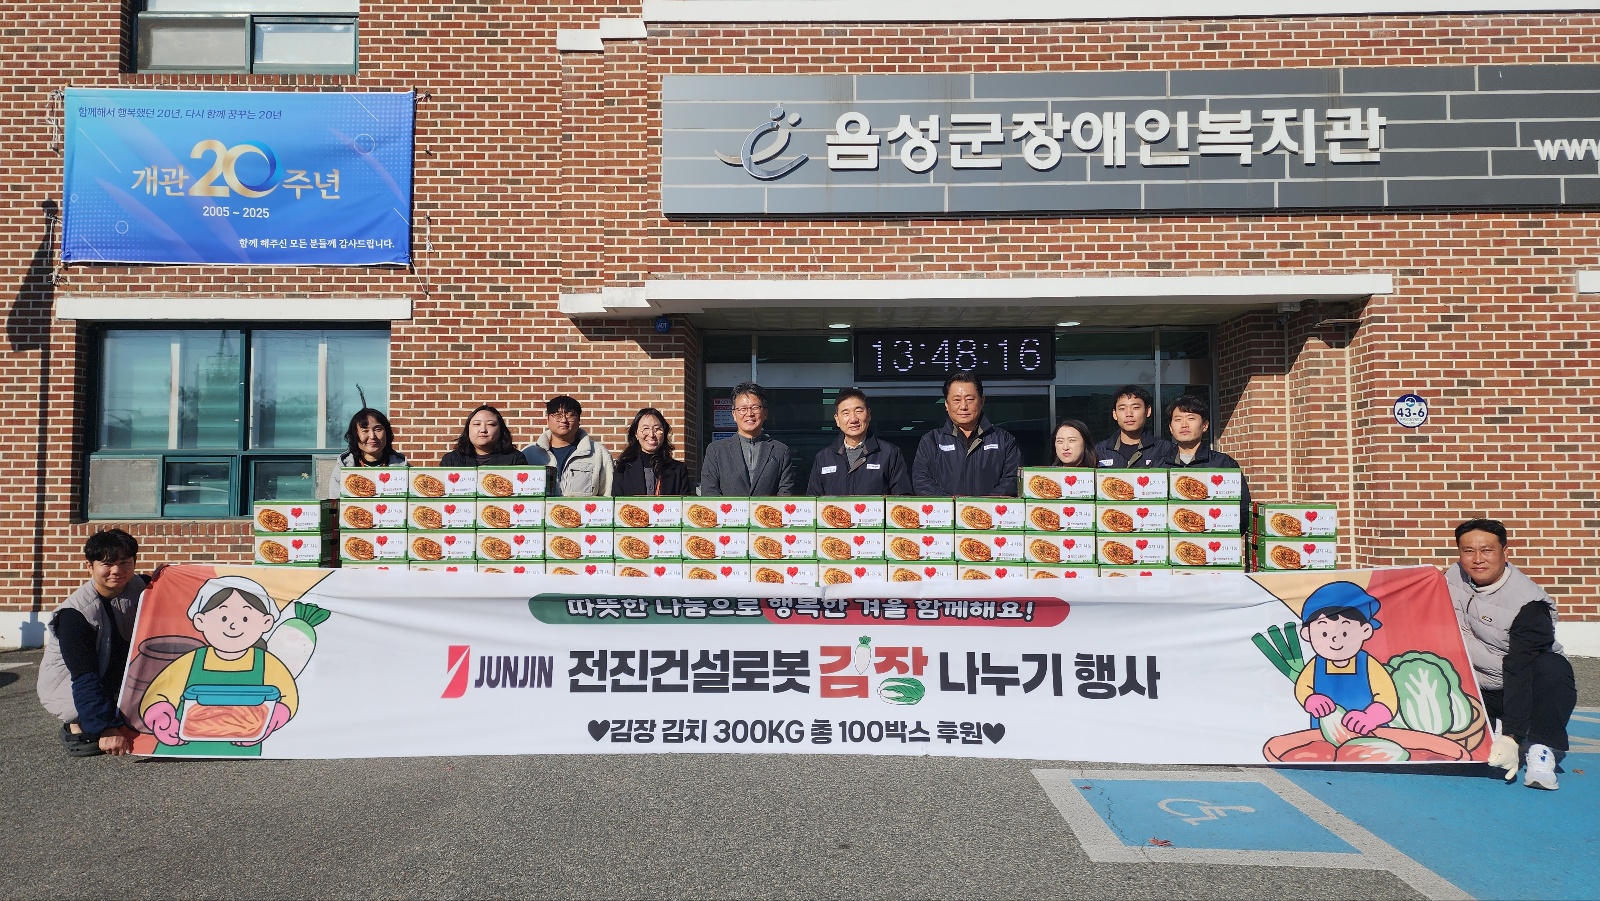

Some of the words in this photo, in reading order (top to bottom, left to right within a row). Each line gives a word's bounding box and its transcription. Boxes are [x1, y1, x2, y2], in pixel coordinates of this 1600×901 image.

[78, 106, 115, 118] 함께해서
[117, 107, 155, 119] 행복했던
[156, 108, 183, 120] 20년,
[185, 108, 205, 119] 다시
[207, 109, 226, 120] 함께
[228, 109, 256, 120] 꿈꾸는
[258, 110, 282, 120] 20년
[826, 106, 1387, 172] 음성군장애인복지관
[202, 206, 230, 218] 2005
[242, 206, 270, 219] 2025
[239, 238, 258, 249] 함께
[260, 238, 287, 249] 해주신
[290, 238, 308, 249] 모든
[309, 238, 337, 249] 분들께
[338, 238, 395, 250] 감사드립니다.
[872, 338, 1042, 372] 13:48:16
[1396, 407, 1425, 418] 43-6
[567, 597, 649, 618] 따뜻한
[655, 597, 763, 618] 나눔으로
[767, 597, 848, 619] 행복한
[854, 598, 908, 619] 겨울
[915, 598, 1036, 621] 함께해요!
[474, 655, 554, 689] JUNJIN
[567, 649, 811, 694] 전진건설로봇
[819, 636, 929, 706] 김장
[939, 651, 1064, 697] 나누기
[1074, 652, 1161, 700] 행사
[610, 719, 657, 744] 김장
[661, 718, 707, 744] 김치
[713, 719, 805, 744] 300KG
[810, 718, 833, 745] 총
[838, 720, 931, 744] 100박스
[936, 719, 984, 745] 후원
